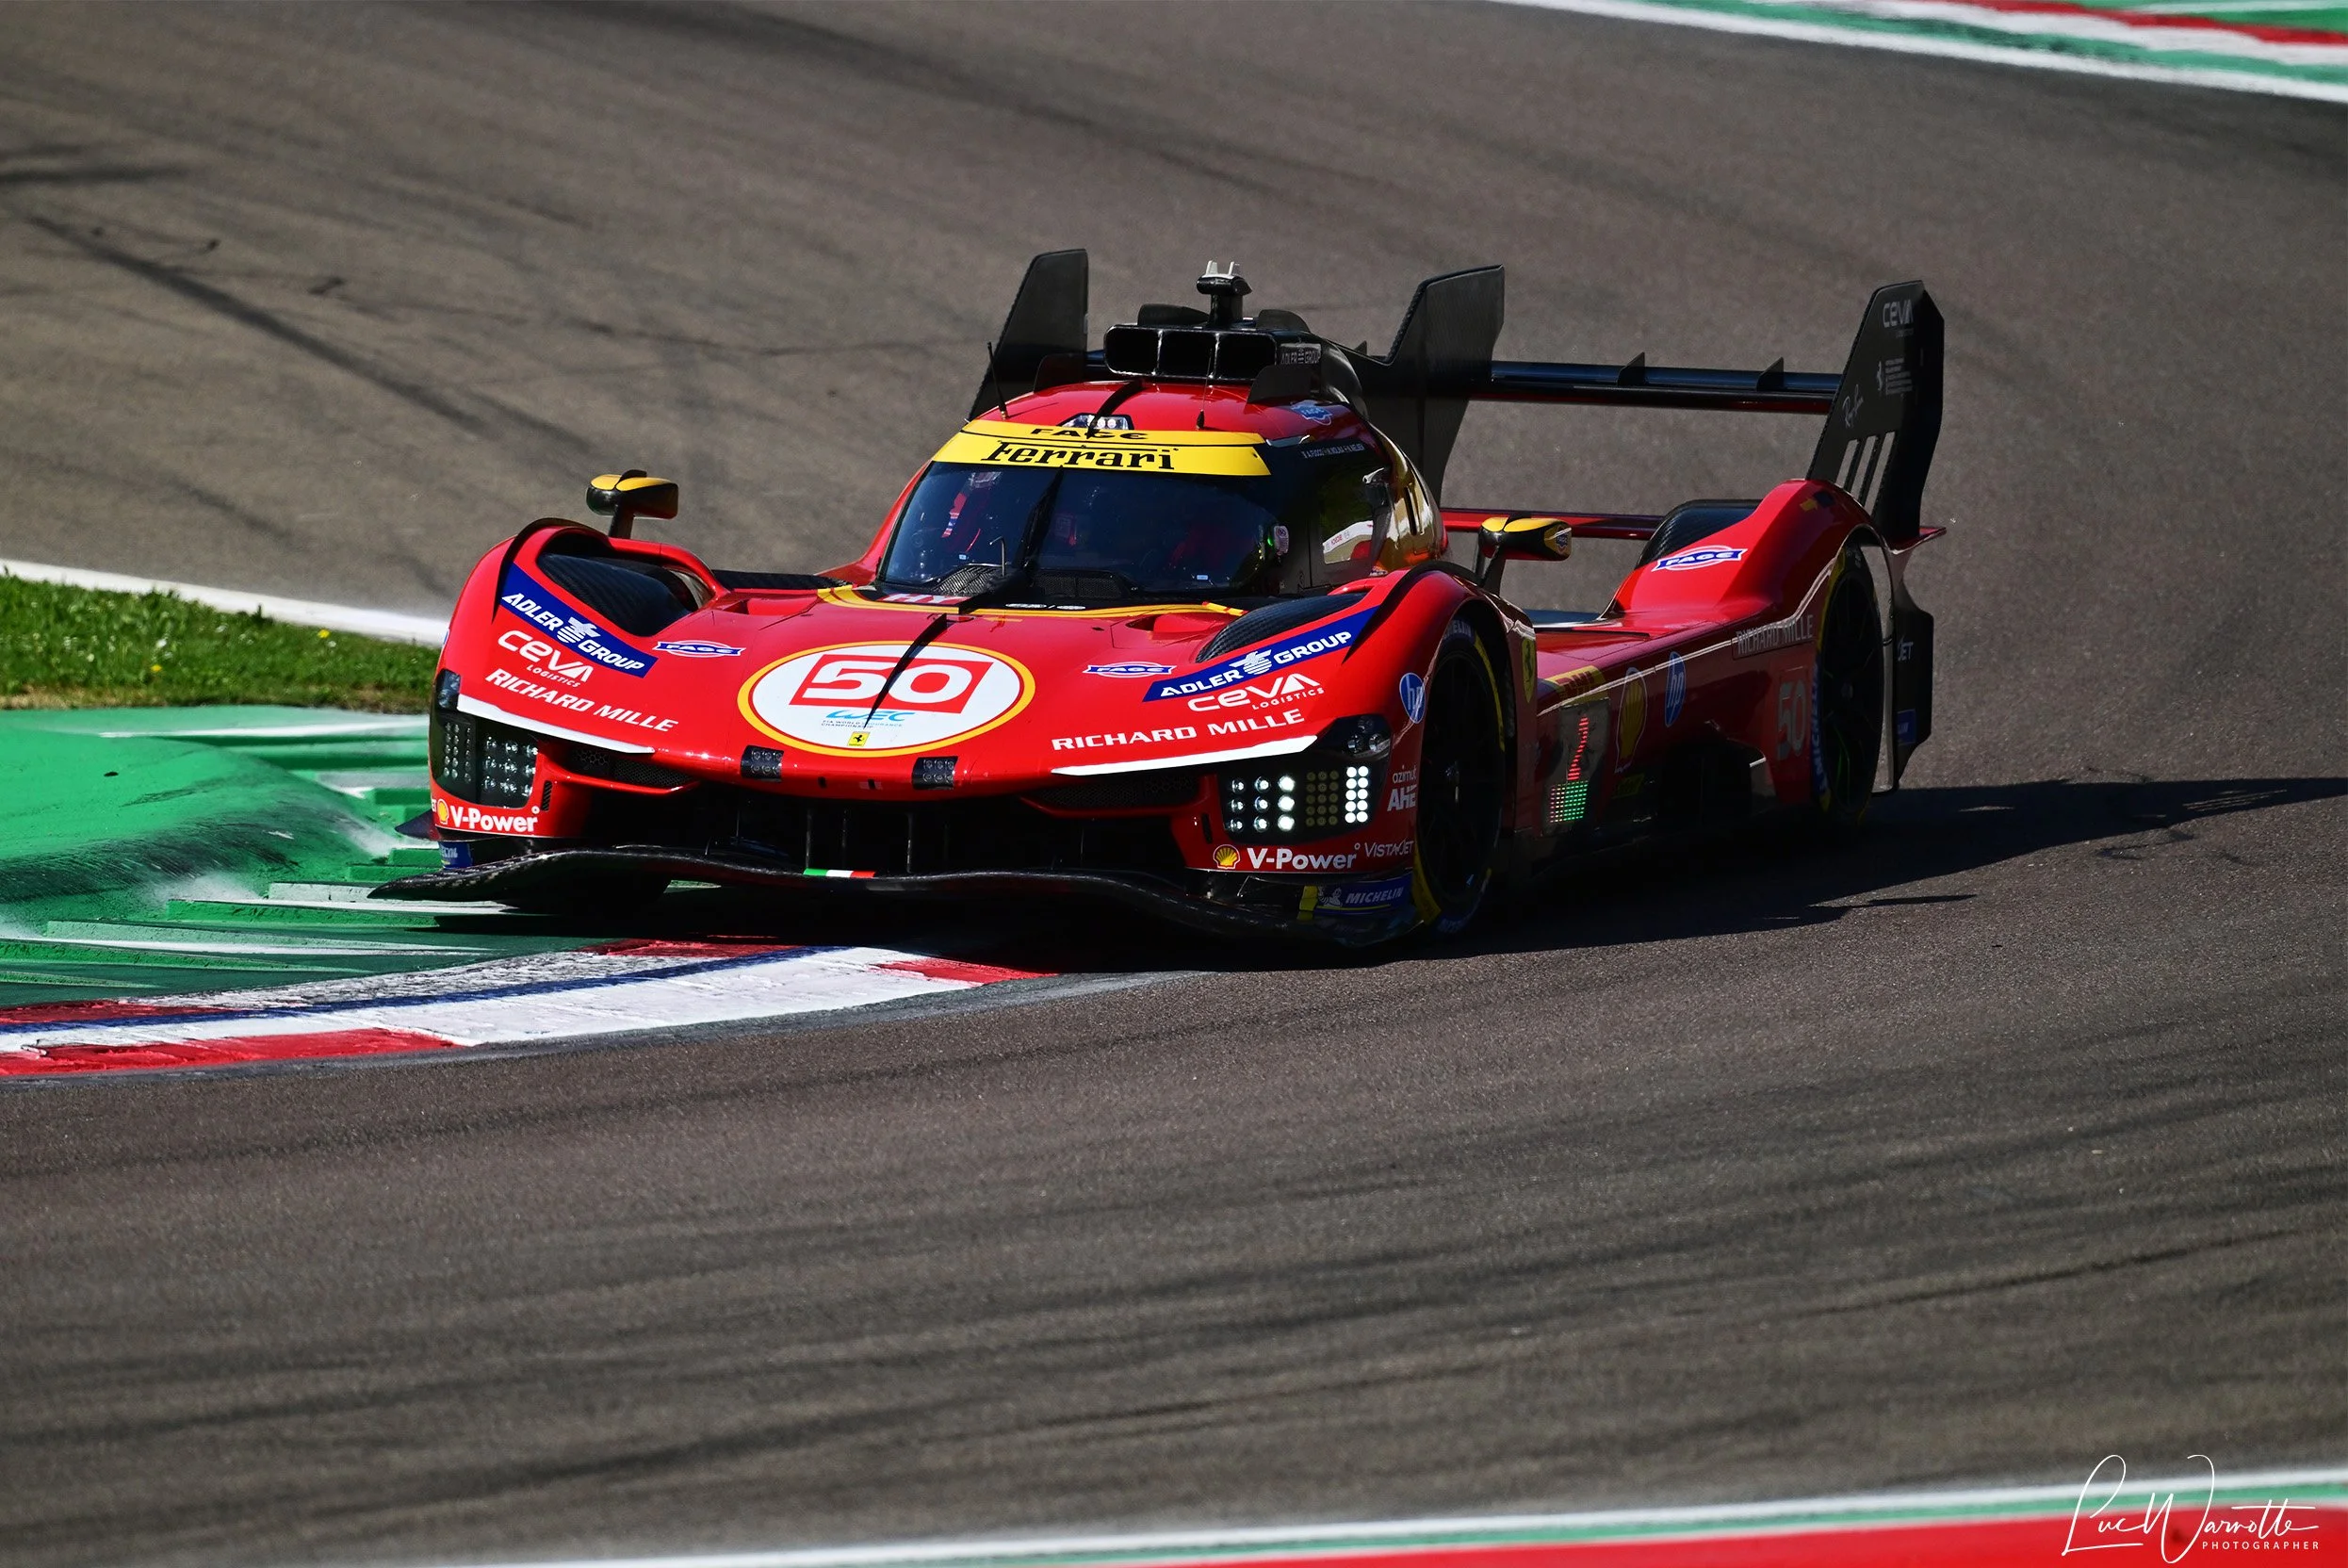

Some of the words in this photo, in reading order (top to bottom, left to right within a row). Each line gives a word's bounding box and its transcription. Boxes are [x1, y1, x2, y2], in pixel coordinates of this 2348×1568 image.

[981, 440, 1175, 470] Ferrari
[501, 592, 563, 632] ADLER
[578, 639, 645, 671] GROUP
[526, 664, 581, 689] LOGISTICS
[801, 660, 973, 704] 50
[1160, 670, 1244, 698] ADLER
[1273, 631, 1352, 665] GROUP
[485, 668, 595, 712] RICHARD
[594, 705, 678, 732] MILLE
[825, 710, 916, 722] WEC
[1252, 687, 1324, 710] LOGISTICS
[1406, 675, 1424, 721] hp
[1052, 726, 1198, 751] RICHARD
[1208, 709, 1305, 736] MILLE
[1777, 679, 1806, 761] 50
[450, 805, 539, 832] V-Power
[1247, 847, 1357, 870] V-Power
[1345, 887, 1405, 905] MICHELIN
